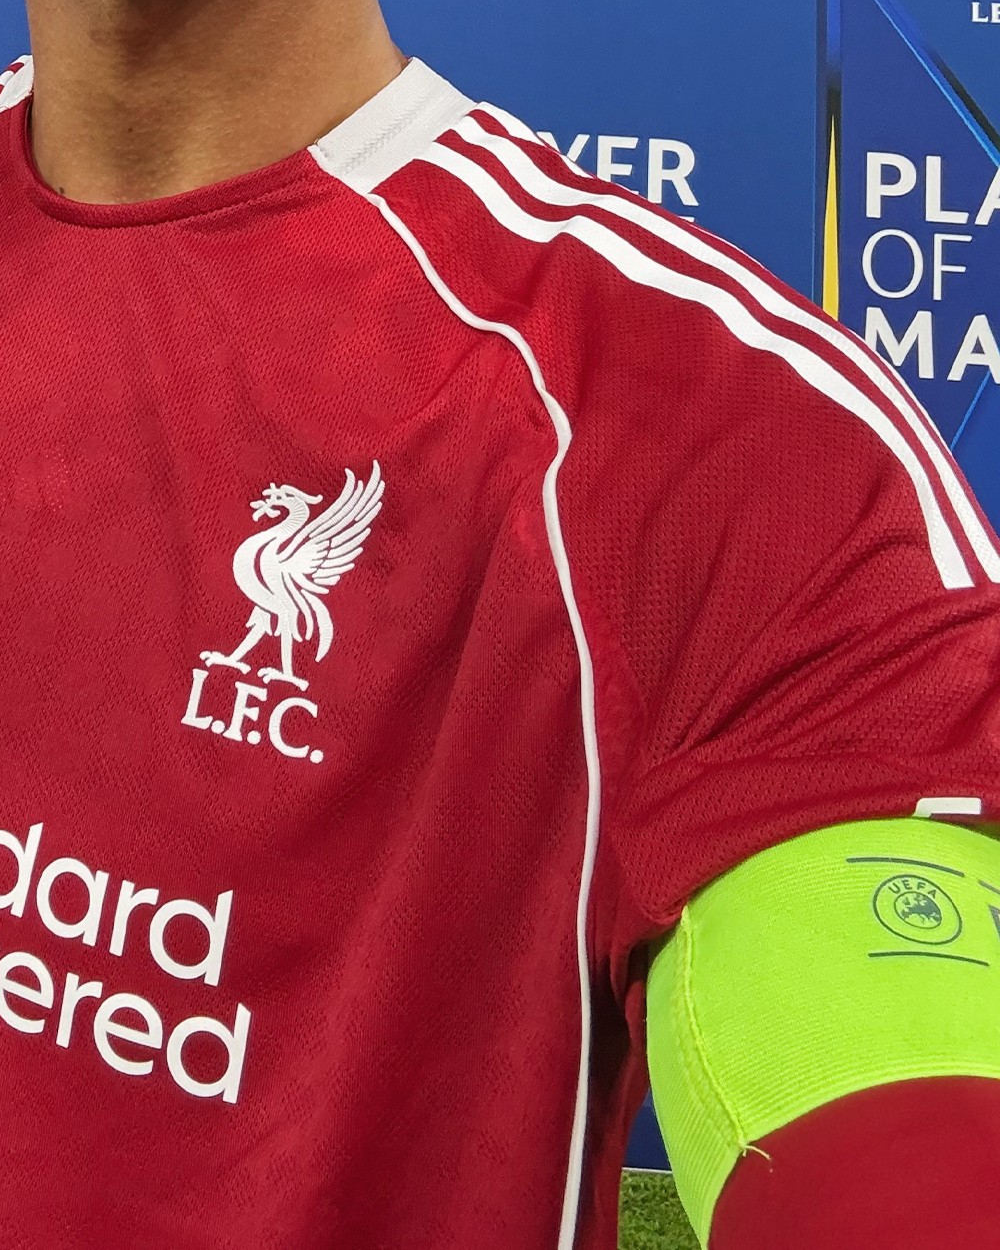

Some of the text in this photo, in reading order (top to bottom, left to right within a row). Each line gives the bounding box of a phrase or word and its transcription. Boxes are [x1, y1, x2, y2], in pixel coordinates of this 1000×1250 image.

[861, 229, 973, 300] OF
[181, 668, 325, 764] L.F.C.
[888, 879, 937, 899] UEFA
